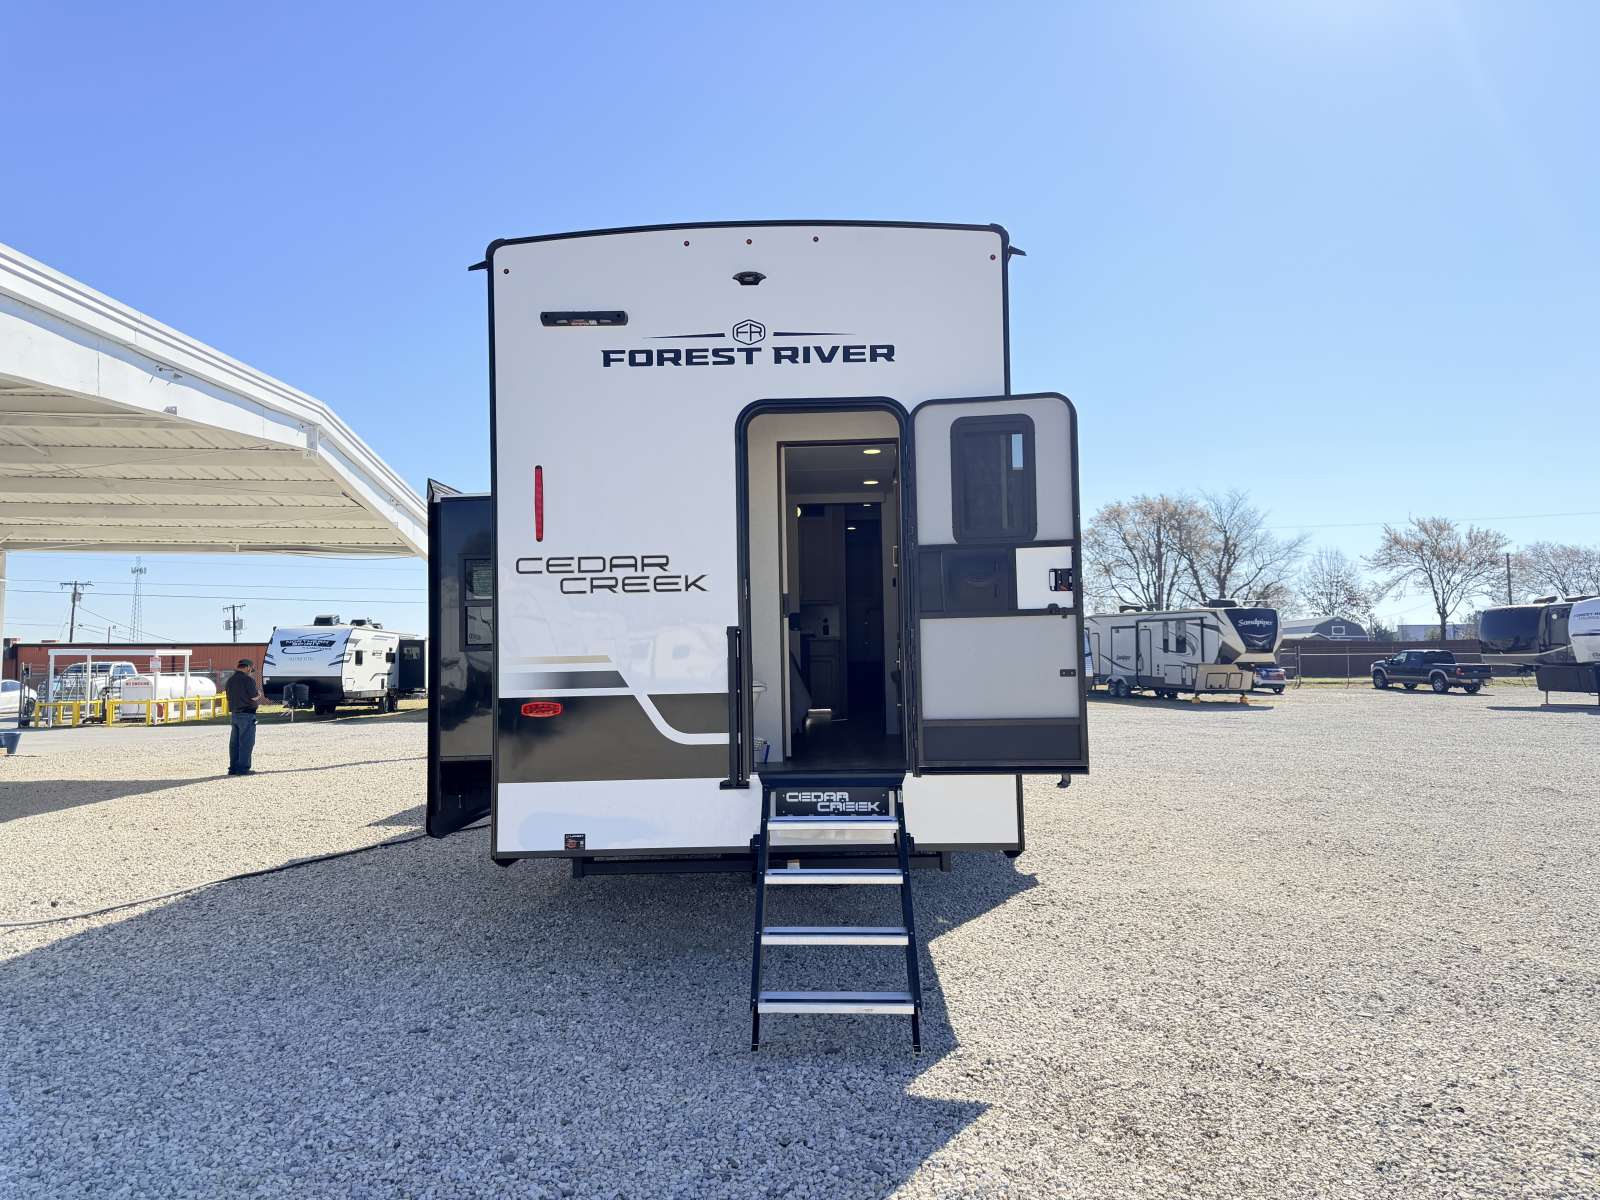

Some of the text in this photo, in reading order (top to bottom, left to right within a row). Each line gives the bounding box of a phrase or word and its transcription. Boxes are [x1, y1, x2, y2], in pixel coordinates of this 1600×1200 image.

[735, 321, 764, 343] FR
[601, 345, 896, 367] FOREST RIVER
[516, 555, 670, 574] CEDAR
[560, 575, 710, 594] CREEK
[786, 792, 849, 802] CEDAR
[817, 802, 880, 812] CREEK
